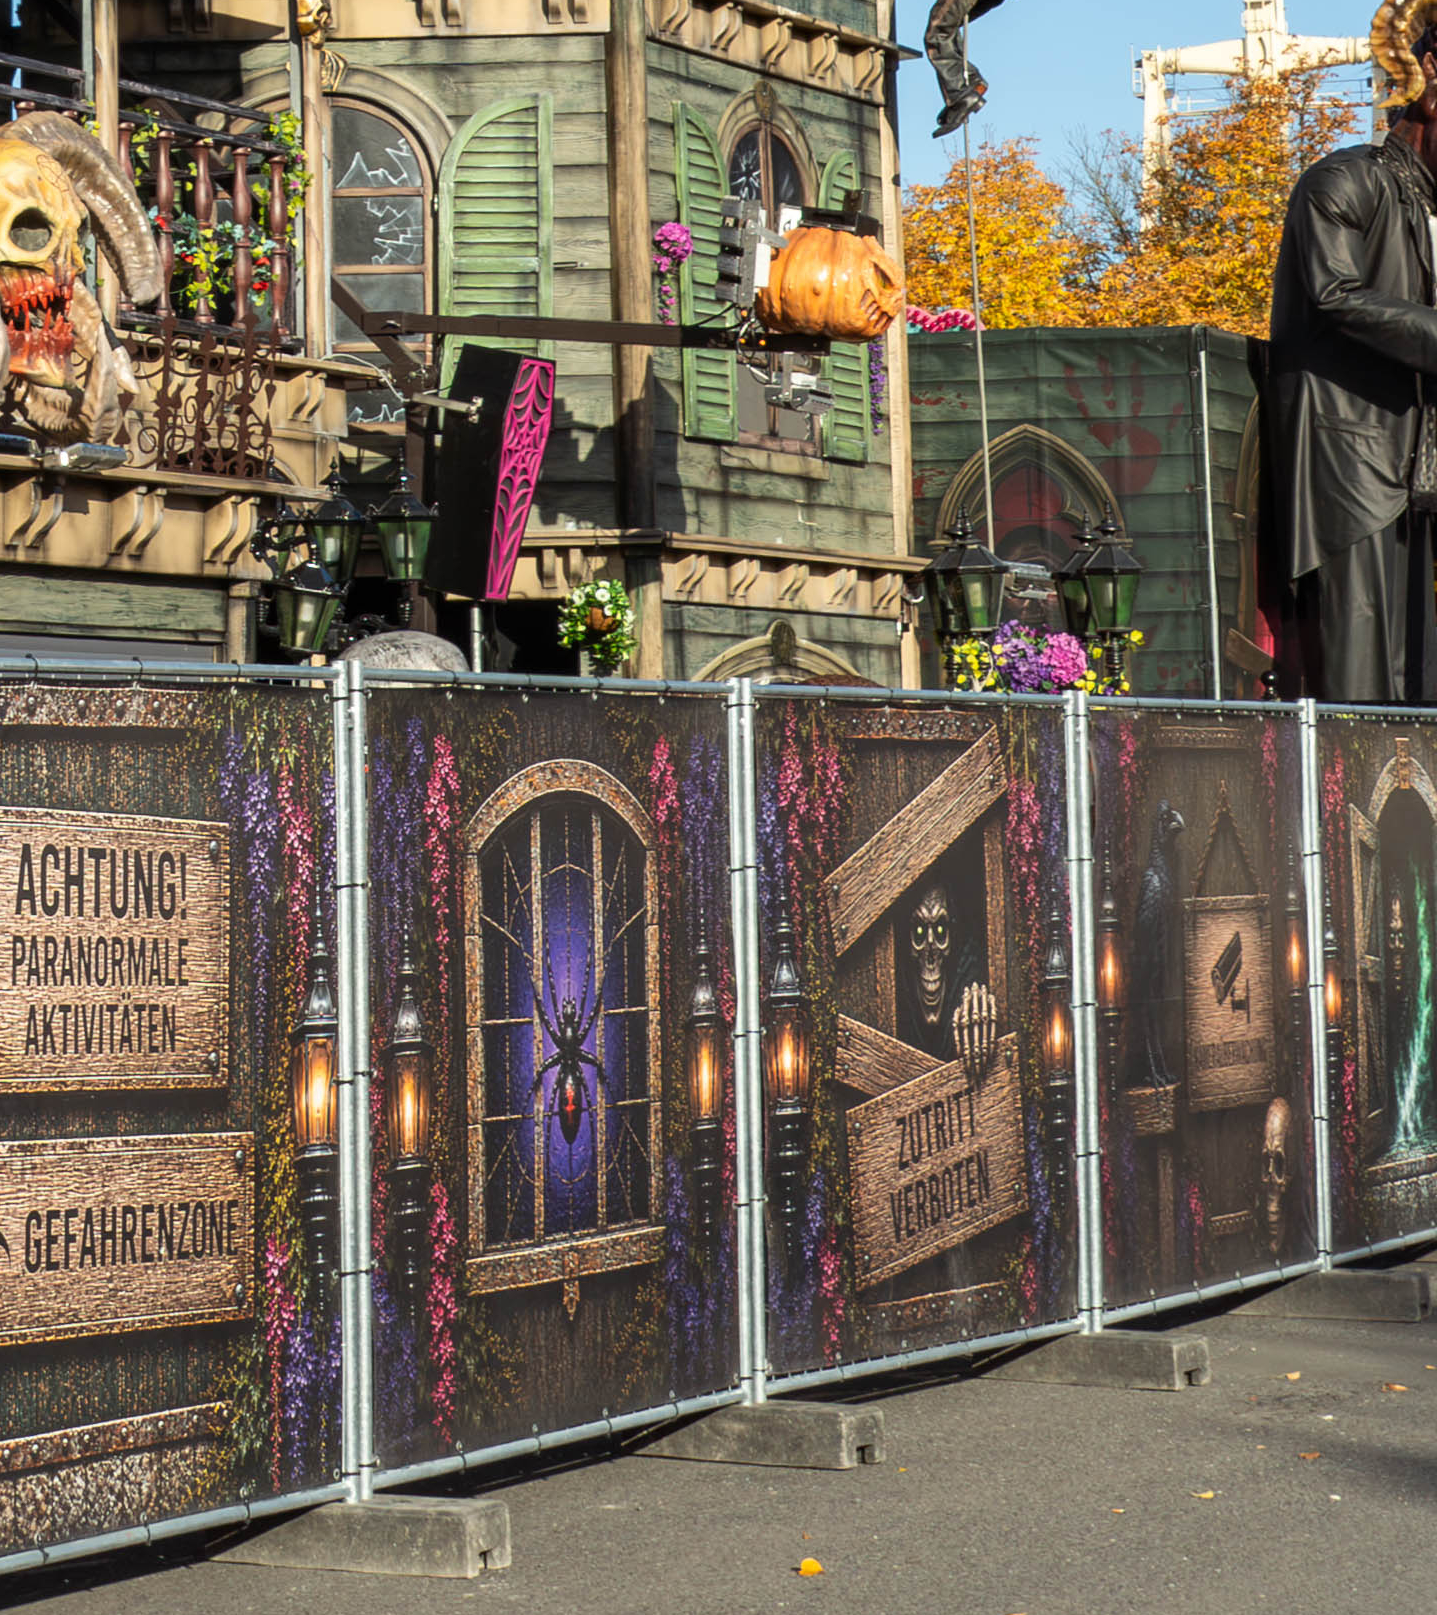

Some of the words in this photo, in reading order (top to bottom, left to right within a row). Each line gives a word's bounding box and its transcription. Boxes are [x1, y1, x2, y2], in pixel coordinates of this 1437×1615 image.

[14, 842, 187, 920] ACHTUNG!
[11, 935, 189, 987] PARANORMALE
[25, 991, 176, 1055] AKTIVITÄTEN
[895, 1088, 975, 1171] ZUTRITT
[889, 1150, 991, 1244] VERBOTEN
[24, 1199, 239, 1274] GEFAHRENZONE
